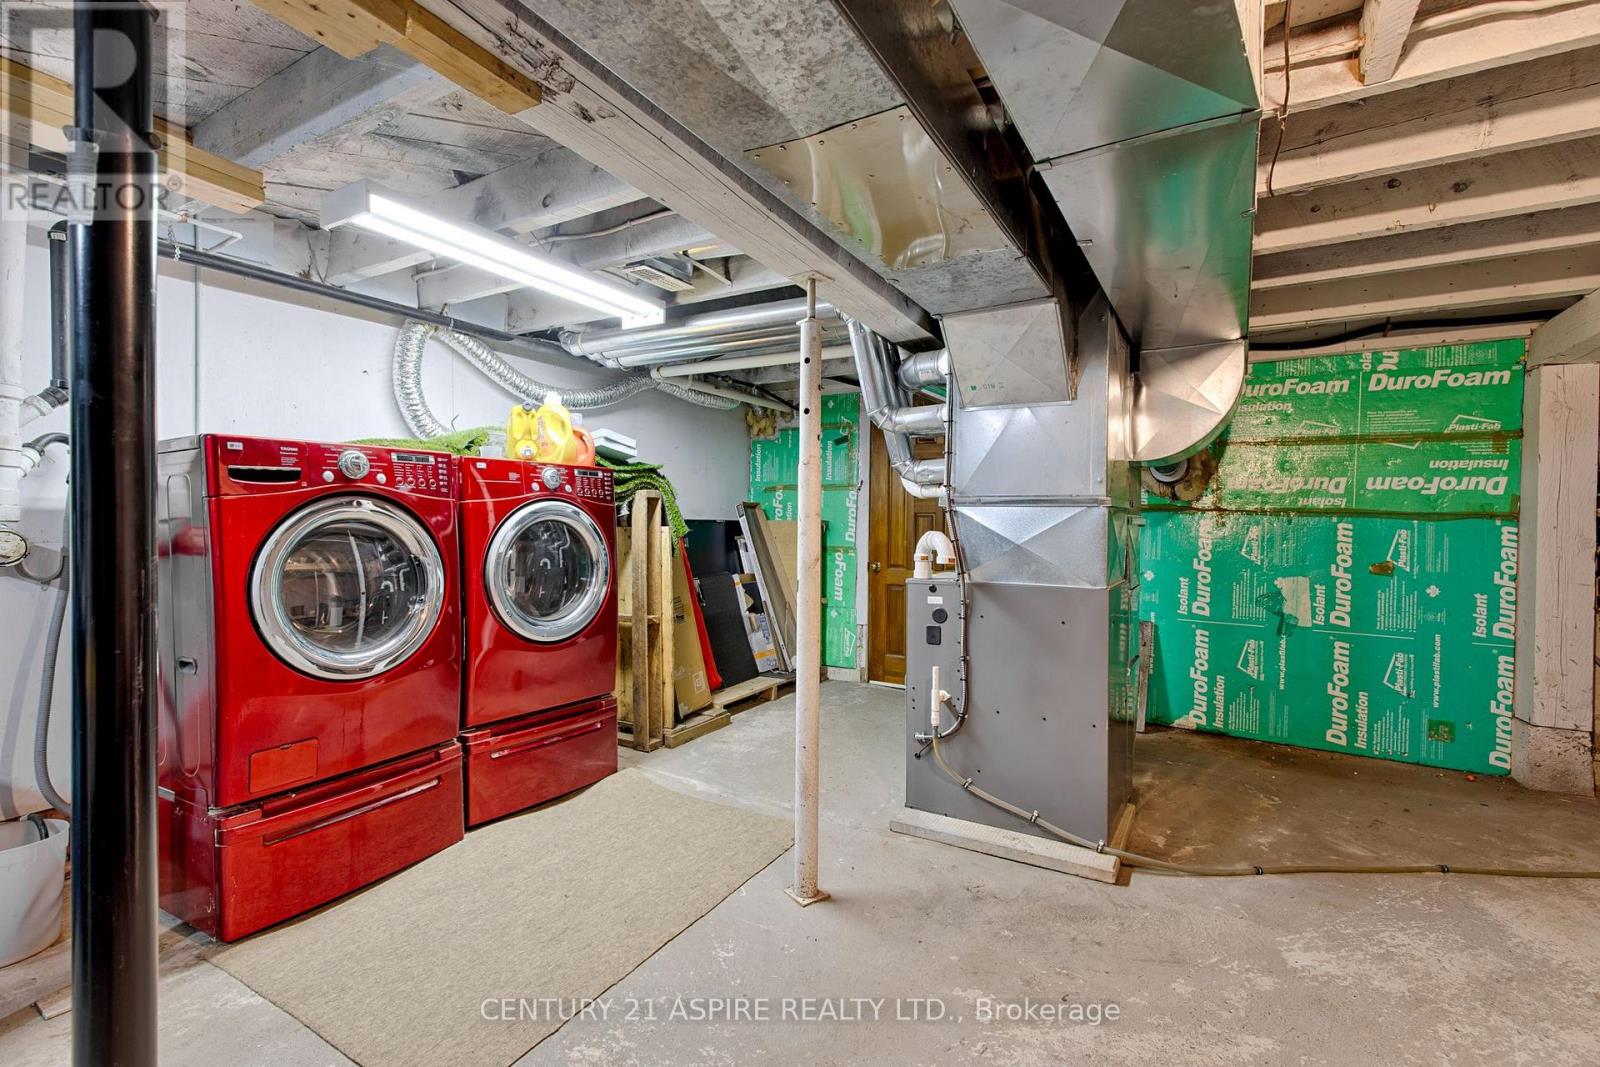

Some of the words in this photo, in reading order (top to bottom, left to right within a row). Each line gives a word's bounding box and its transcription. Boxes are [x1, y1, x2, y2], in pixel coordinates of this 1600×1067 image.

[1244, 379, 1350, 397] uroFoam
[1368, 369, 1511, 391] DuroFoam
[825, 440, 833, 481] Insulation
[1366, 476, 1508, 495] DuroFoam
[1429, 459, 1509, 471] Insulation
[845, 490, 857, 542] DuroFo
[834, 548, 847, 602] roFoam
[1177, 576, 1189, 615] Isolant
[1329, 522, 1354, 628] DuroFoam
[1492, 526, 1519, 640] DuroFoam
[1313, 584, 1326, 625] Isolant
[1472, 593, 1488, 638] Isolant
[1188, 629, 1210, 726] DuroFoam
[1325, 640, 1350, 746] DuroFoam
[1432, 634, 1441, 708] www.plastifab.com
[1213, 674, 1225, 728] Insulation
[1354, 691, 1368, 749] Insulation
[1488, 655, 1515, 770] DuroFoam
